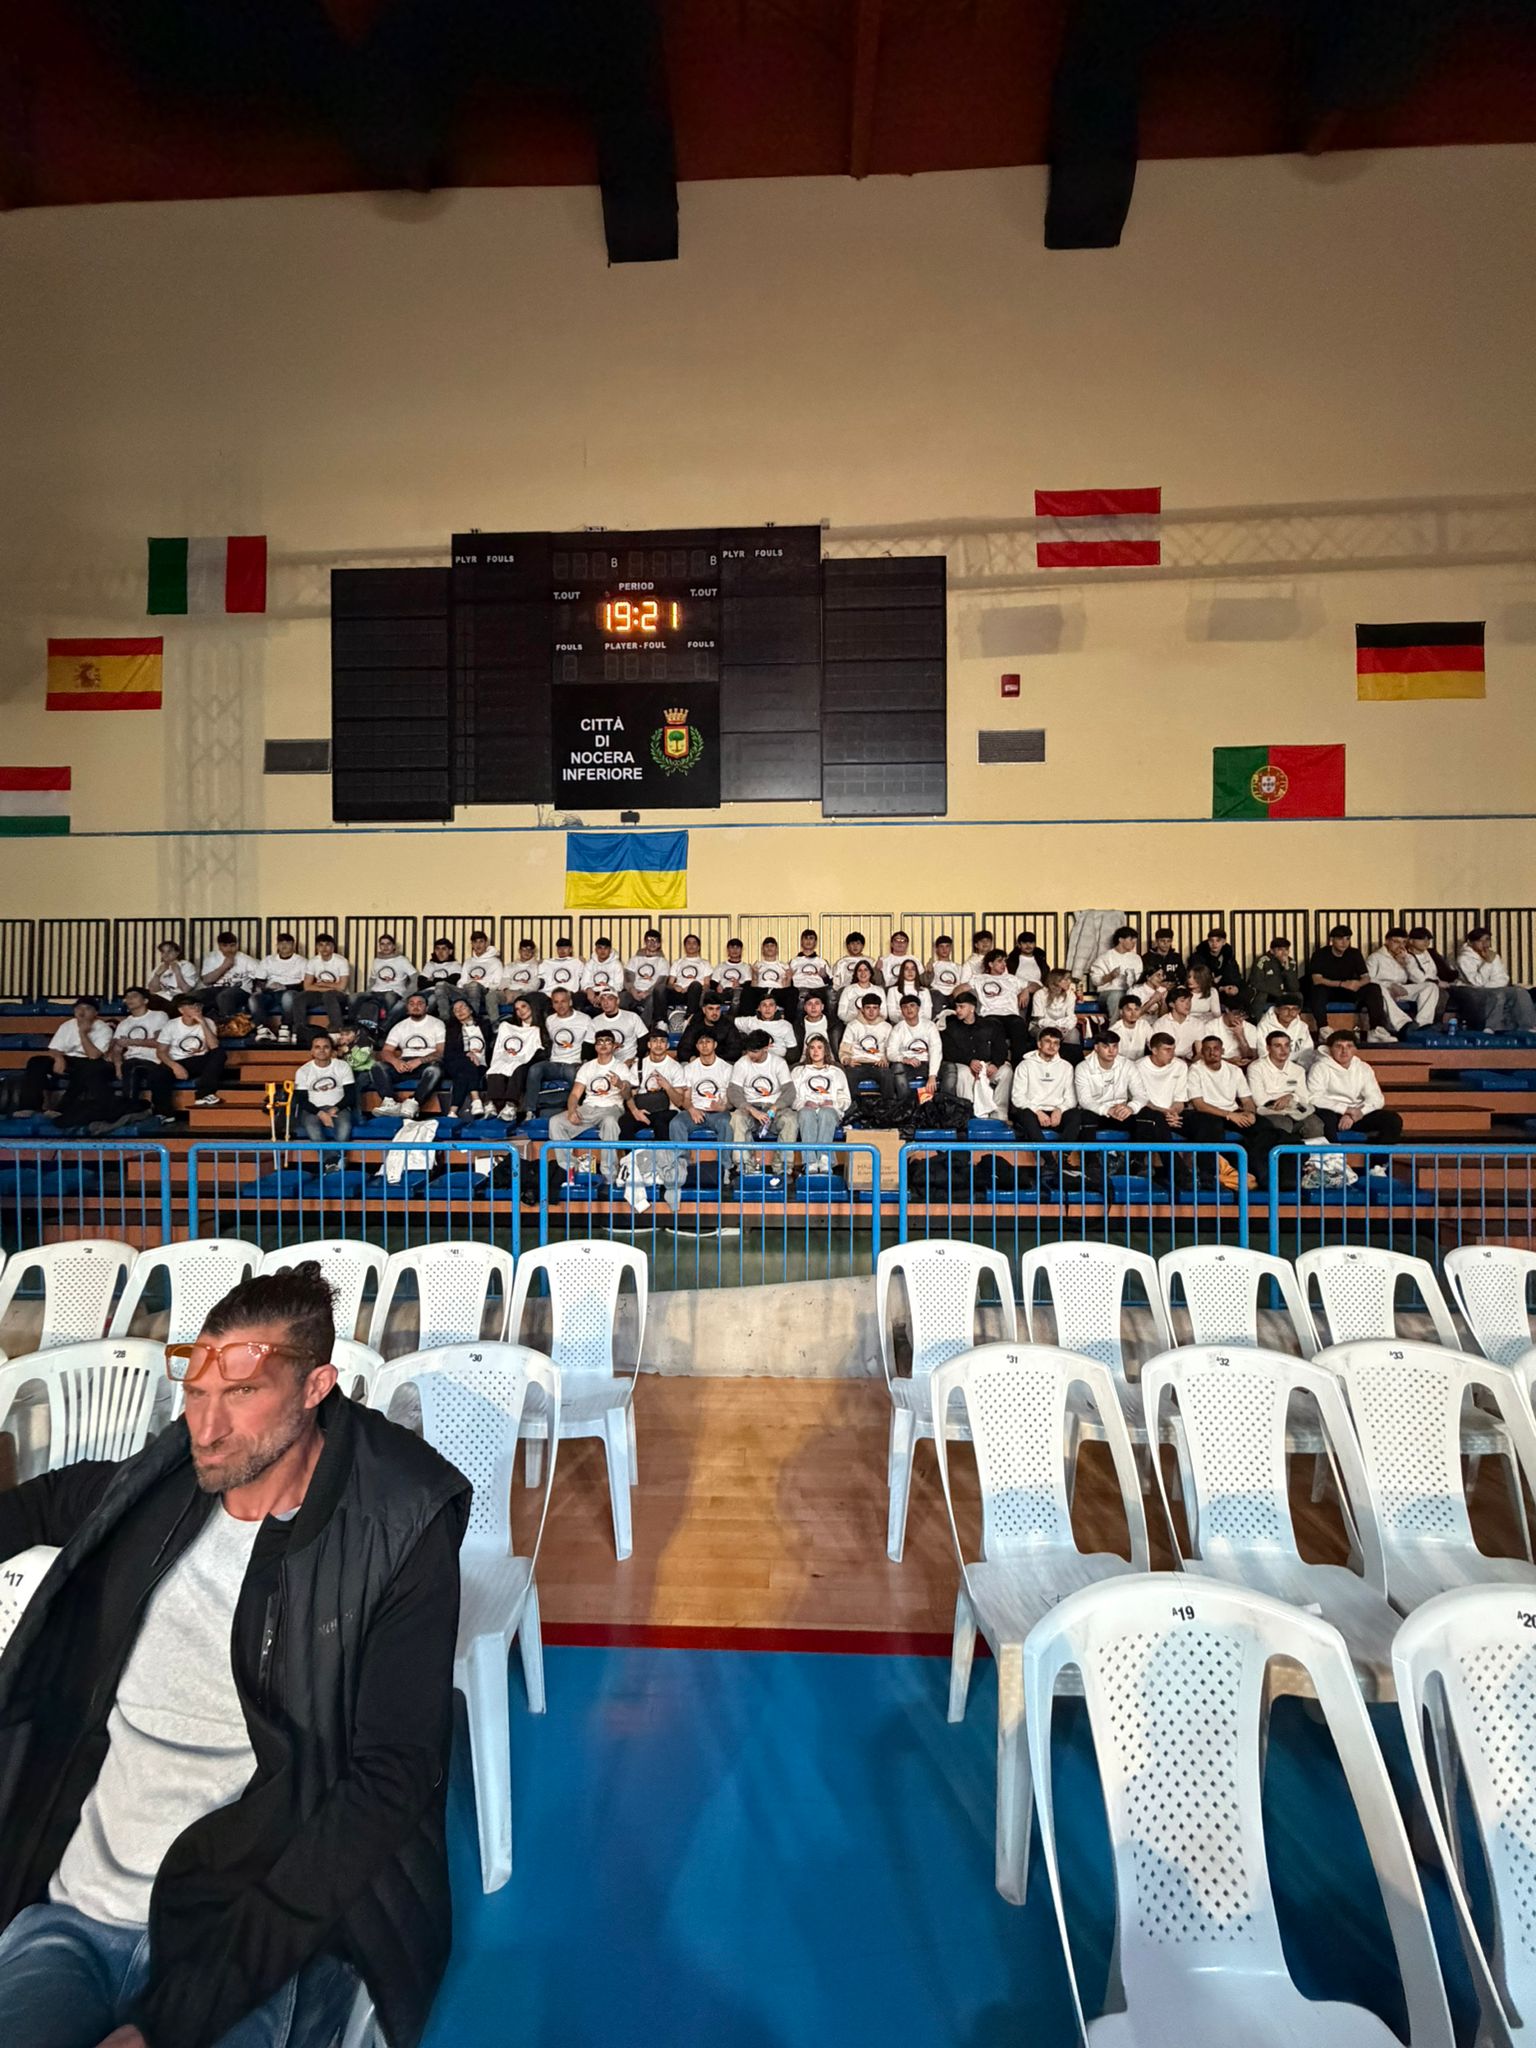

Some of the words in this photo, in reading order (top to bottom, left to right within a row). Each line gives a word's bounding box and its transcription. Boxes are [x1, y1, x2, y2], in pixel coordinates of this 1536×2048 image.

[455, 555, 478, 564] PLYR
[486, 555, 515, 563] FOULS
[722, 550, 745, 559] PLYR
[754, 549, 784, 557] FOULS
[618, 582, 655, 591] PERIOD
[553, 591, 581, 600] T.OUT
[689, 588, 718, 597] T.OUT
[604, 600, 679, 632] 19:21
[555, 643, 583, 651] FOULS
[687, 640, 715, 648] FOULS
[580, 715, 625, 732] CITTÀ
[594, 734, 610, 748] DI
[570, 751, 635, 764] NOCERA
[562, 767, 643, 781] INFERIORE
[3, 1570, 25, 1588] A17
[1172, 1605, 1196, 1622] A19
